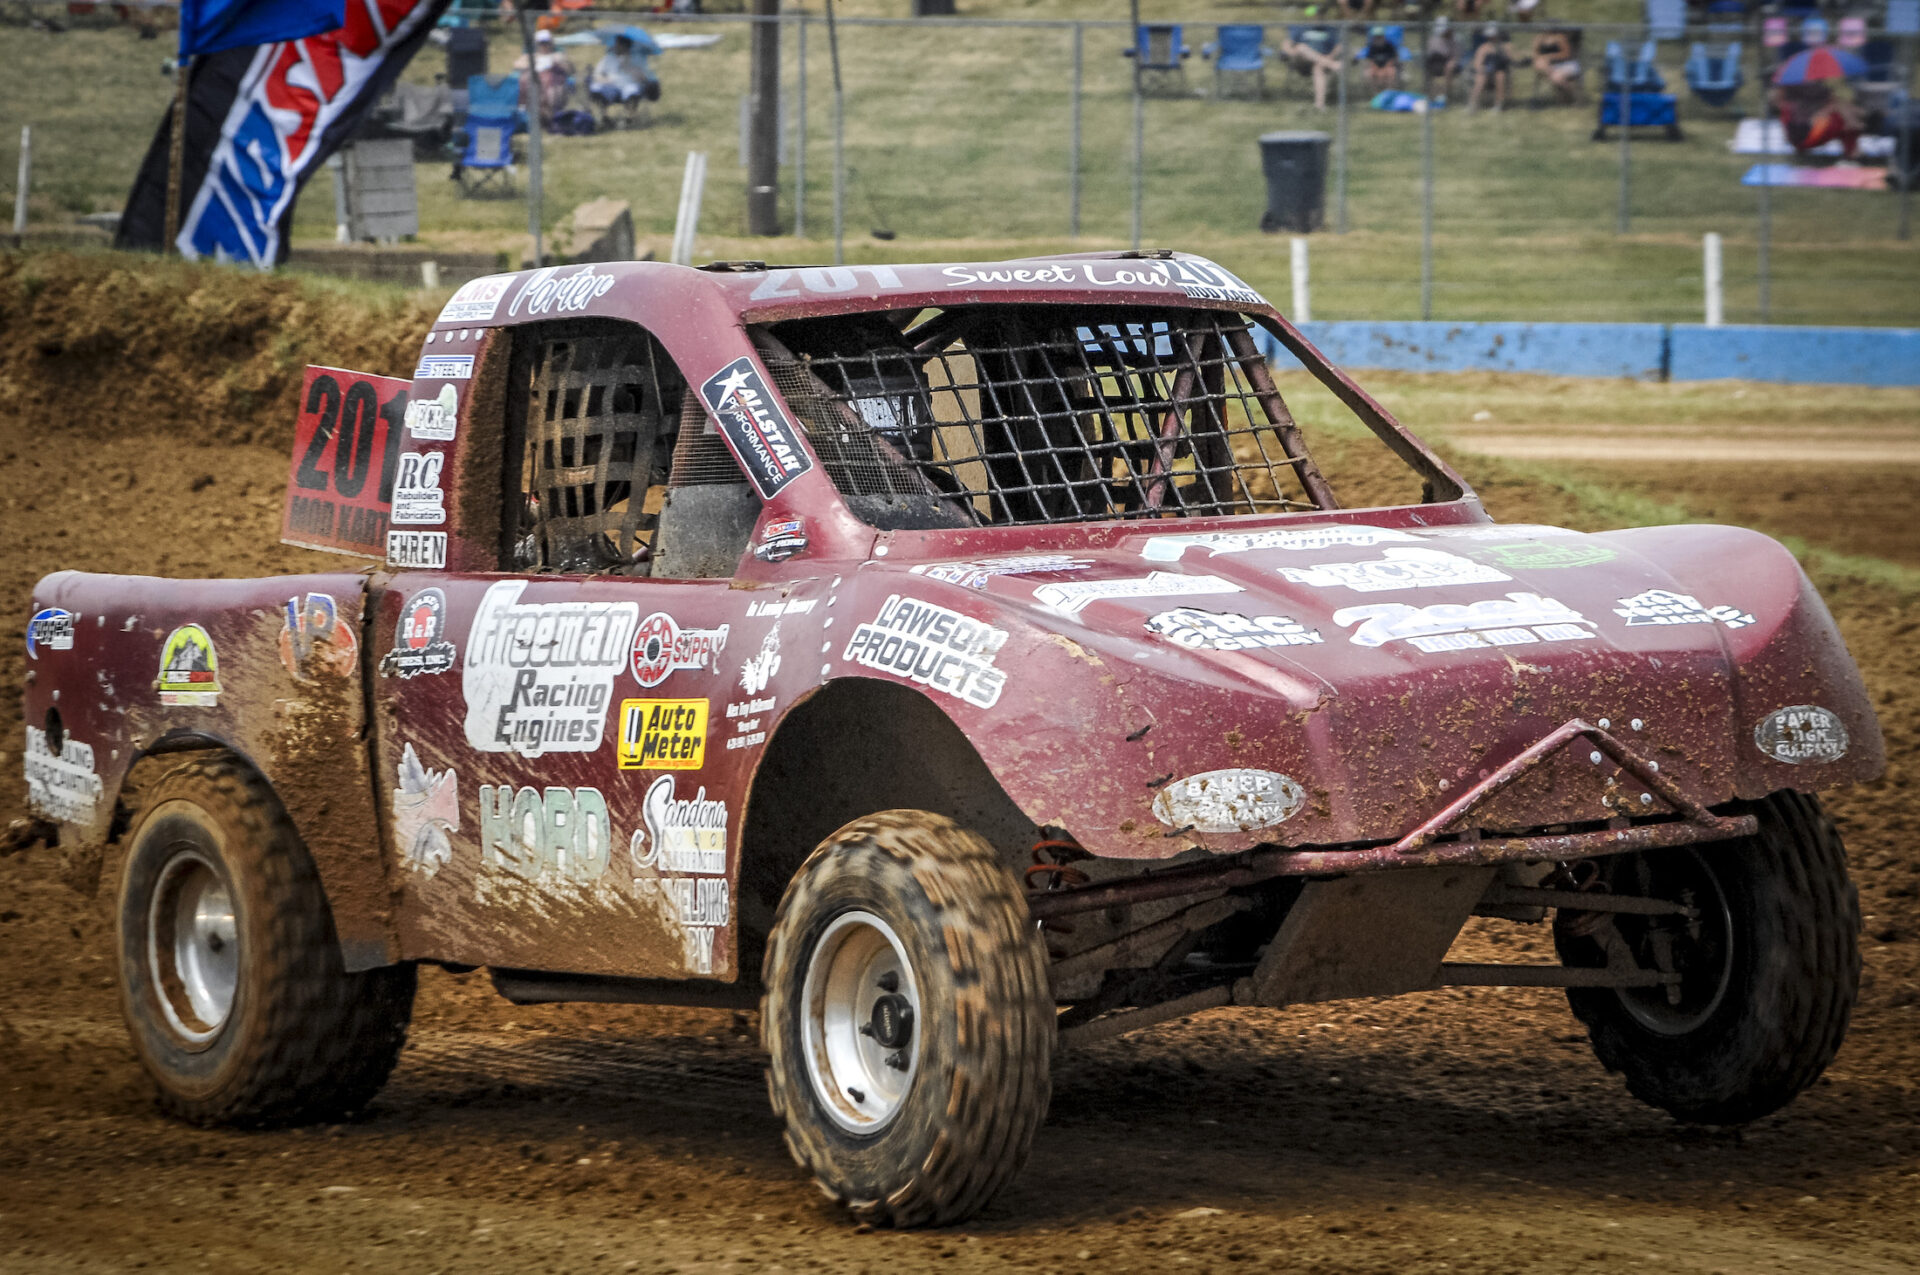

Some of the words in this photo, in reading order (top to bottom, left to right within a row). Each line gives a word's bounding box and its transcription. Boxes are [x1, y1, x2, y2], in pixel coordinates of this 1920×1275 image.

[508, 265, 616, 317] Porter
[740, 267, 903, 301] 201
[942, 266, 1076, 287] Sweet
[1082, 265, 1168, 287] Lou
[1182, 284, 1221, 299] MOD
[1218, 287, 1264, 304] KART
[296, 374, 408, 504] 201
[725, 395, 785, 485] PERFORMANCE
[737, 387, 802, 472] ALLSTAR
[398, 457, 441, 490] RC
[396, 491, 440, 501] Rebuilders
[396, 502, 412, 511] and
[394, 510, 442, 521] Fabricators
[388, 534, 447, 565] EHREN
[467, 582, 637, 669] Freeman
[1410, 627, 1541, 653] TRUCING
[848, 628, 1004, 704] PRODUCTS
[509, 669, 608, 714] Racing
[494, 704, 600, 750] Engines
[647, 704, 696, 731] Auto
[641, 732, 702, 760] Meter
